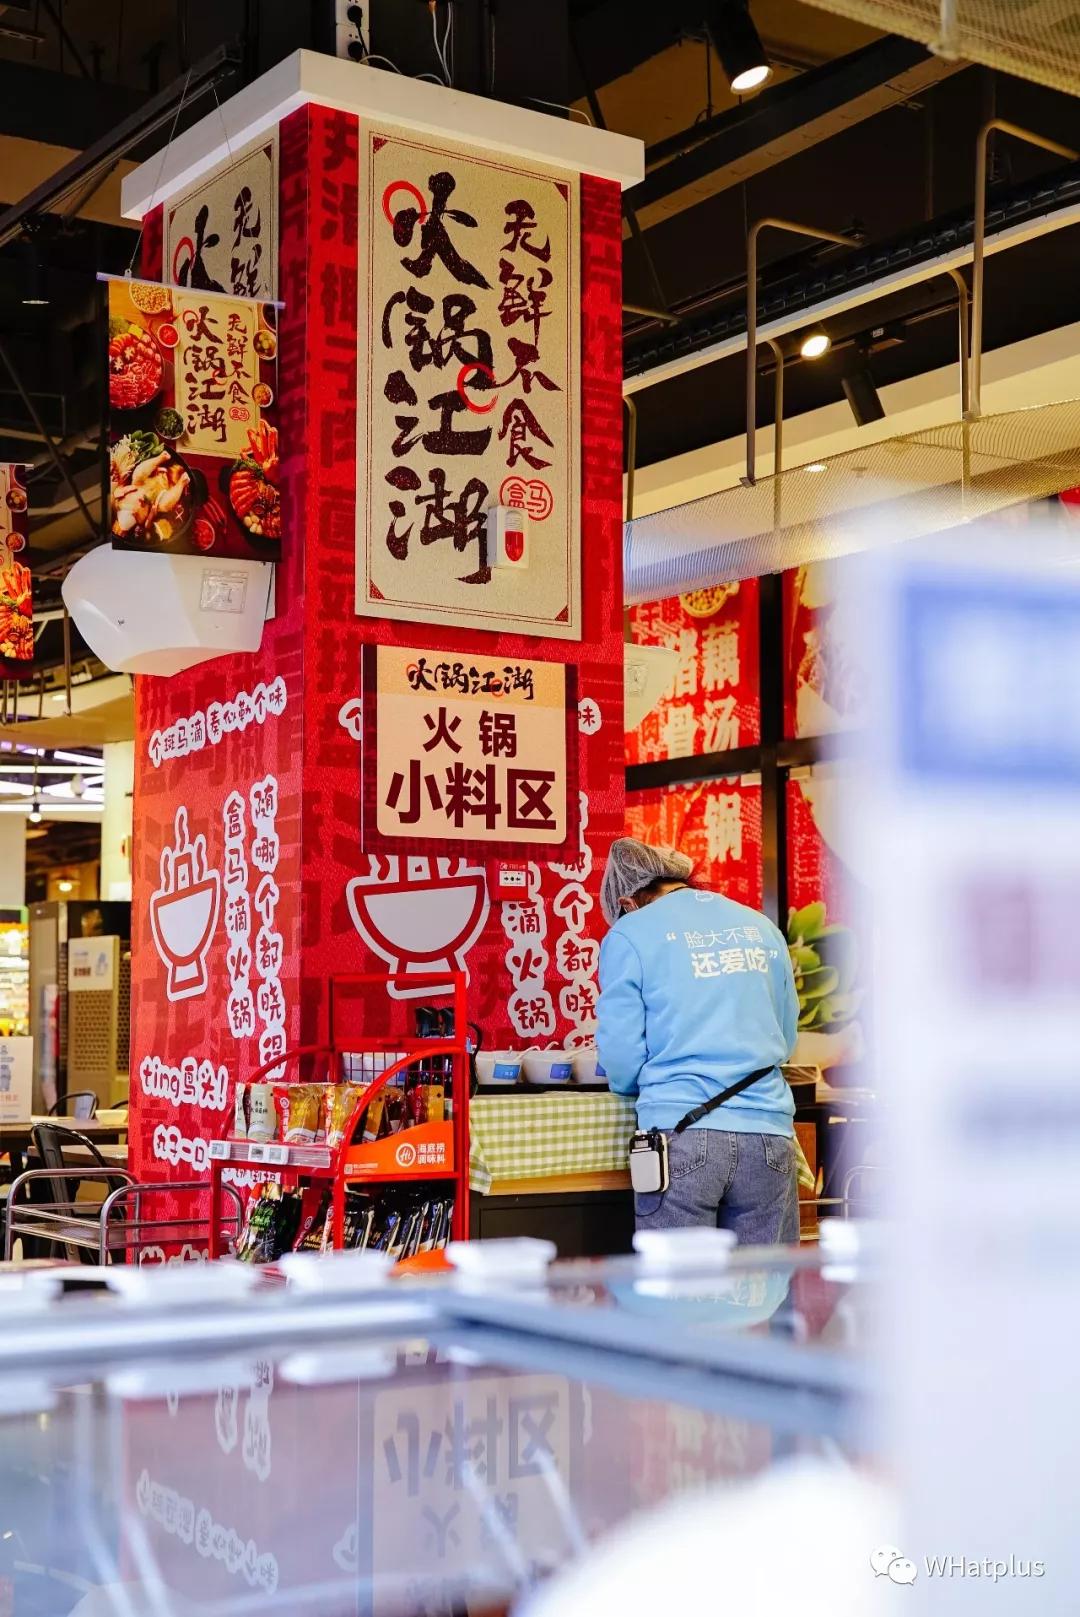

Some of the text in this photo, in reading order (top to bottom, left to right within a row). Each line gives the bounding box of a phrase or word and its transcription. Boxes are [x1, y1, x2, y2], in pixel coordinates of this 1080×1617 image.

[184, 306, 228, 443] 火锅江湖
[382, 171, 495, 585] 火锅江湖
[230, 408, 249, 421] 盒马
[504, 480, 550, 520] 盒马
[407, 657, 535, 700] 火锅江湖
[423, 706, 517, 758] 火锅
[385, 759, 557, 830] 小料区
[226, 799, 252, 1030] 盒马滴火锅
